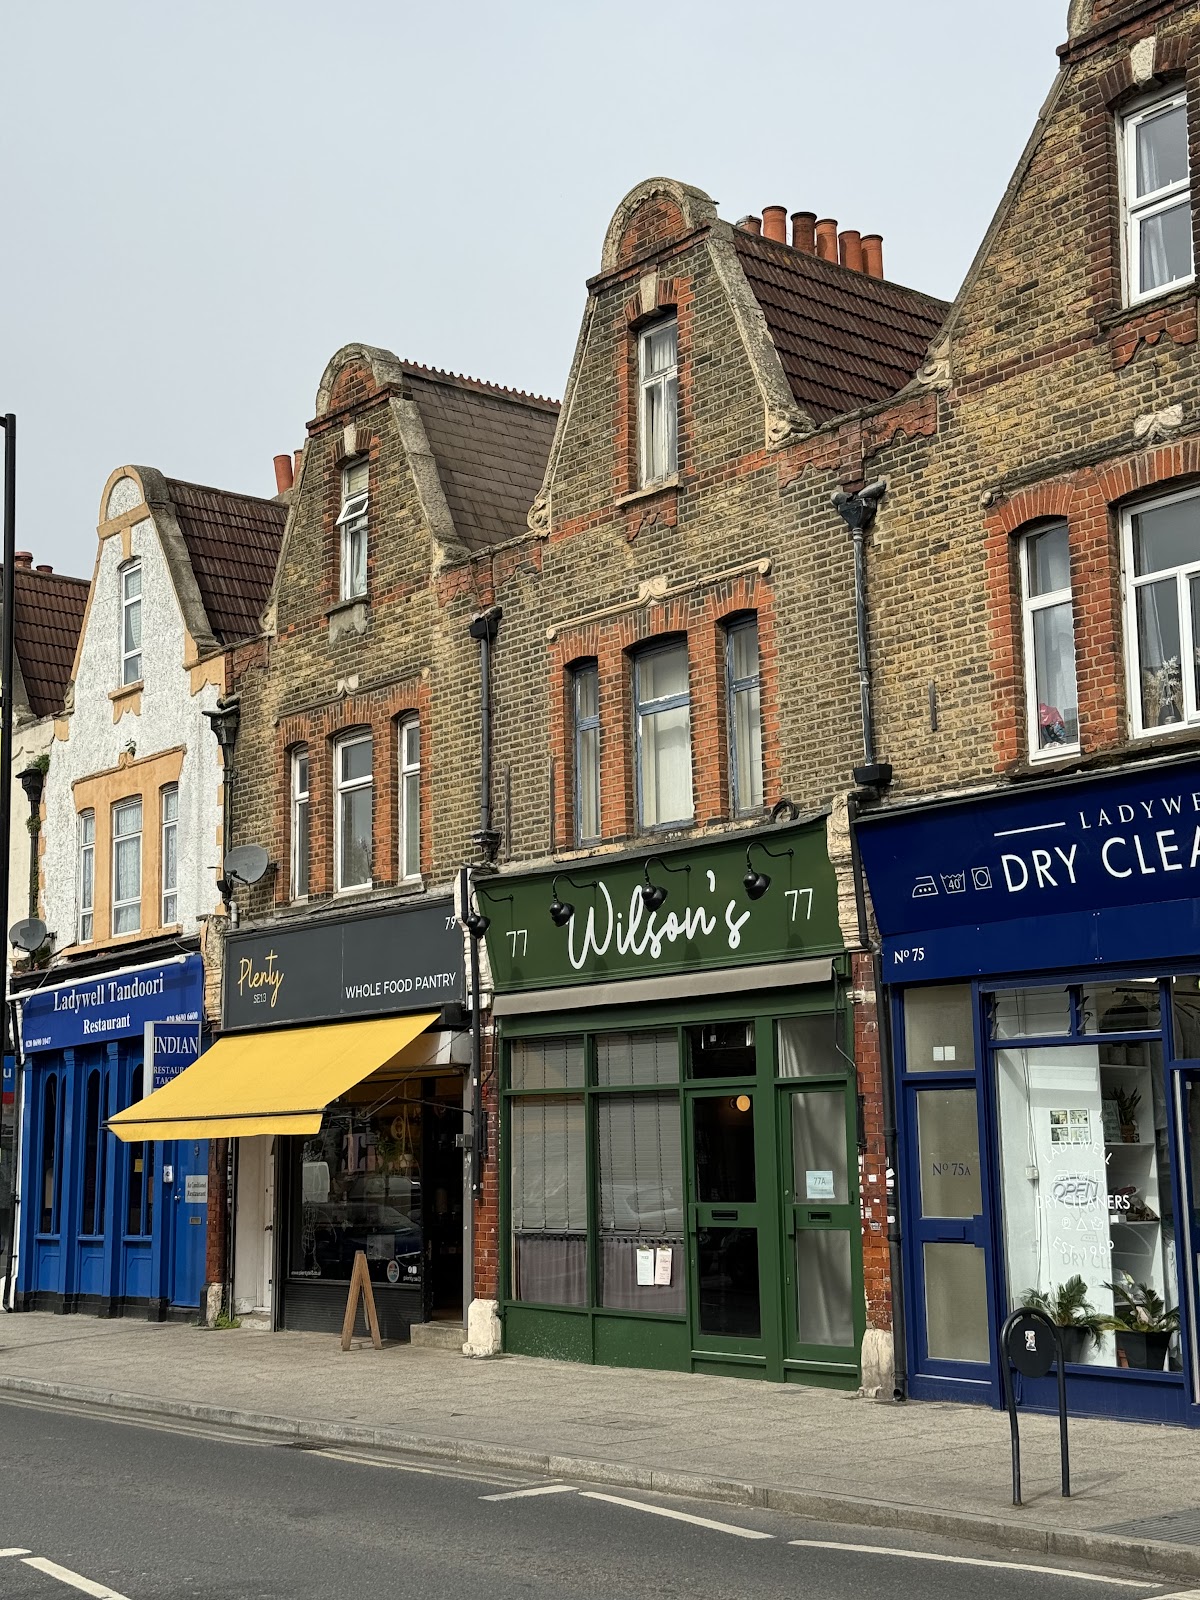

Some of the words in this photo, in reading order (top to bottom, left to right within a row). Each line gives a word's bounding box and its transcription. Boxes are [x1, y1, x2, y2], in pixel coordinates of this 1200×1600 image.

[1001, 844, 1077, 893] DRY
[784, 888, 813, 922] 77
[445, 916, 456, 930] 79
[566, 869, 751, 970] Wilson's
[506, 929, 528, 958] 77
[912, 947, 925, 962] 75
[237, 949, 285, 1008] Plenty
[345, 982, 382, 999] WHOLE
[383, 978, 413, 995] FOOD
[415, 972, 457, 991] PANTRY
[53, 984, 105, 1014] Ladywell
[108, 971, 164, 1003] Tandoori
[253, 993, 267, 1004] SE13
[83, 1013, 131, 1035] Restaurant
[154, 1036, 198, 1054] INDIAN
[154, 1065, 188, 1075] RESTAUR
[1042, 1137, 1113, 1165] LADYWELL
[813, 1176, 827, 1186] 77A
[1053, 1182, 1098, 1198] OPEN
[1036, 1195, 1058, 1210] DRY
[1064, 1194, 1131, 1210] CLEANERS
